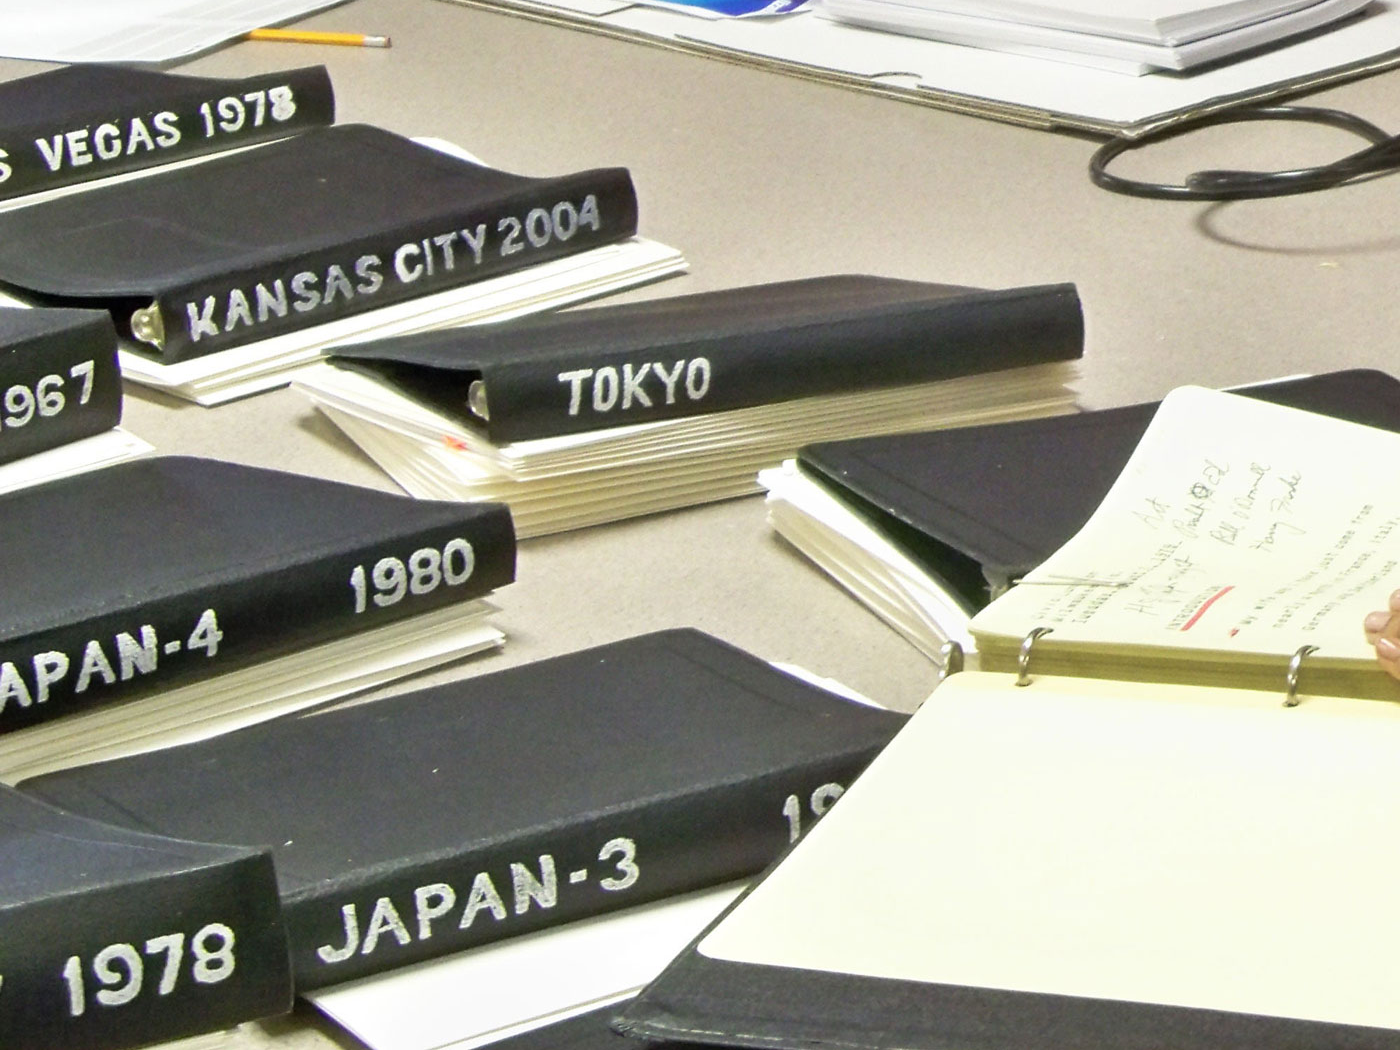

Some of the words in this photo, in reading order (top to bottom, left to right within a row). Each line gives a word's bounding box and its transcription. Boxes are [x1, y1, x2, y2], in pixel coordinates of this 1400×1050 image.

[35, 110, 181, 171] VEGAS
[201, 85, 297, 137] 1978
[187, 254, 383, 342] KANSAS
[394, 224, 486, 283] CITY
[500, 194, 600, 255] 2004
[0, 359, 95, 427] 967
[557, 357, 711, 415] TOKYO
[350, 538, 475, 613] 1980
[318, 838, 640, 964] JAPAN-3
[782, 782, 846, 844] 19
[63, 922, 236, 1017] 1978
